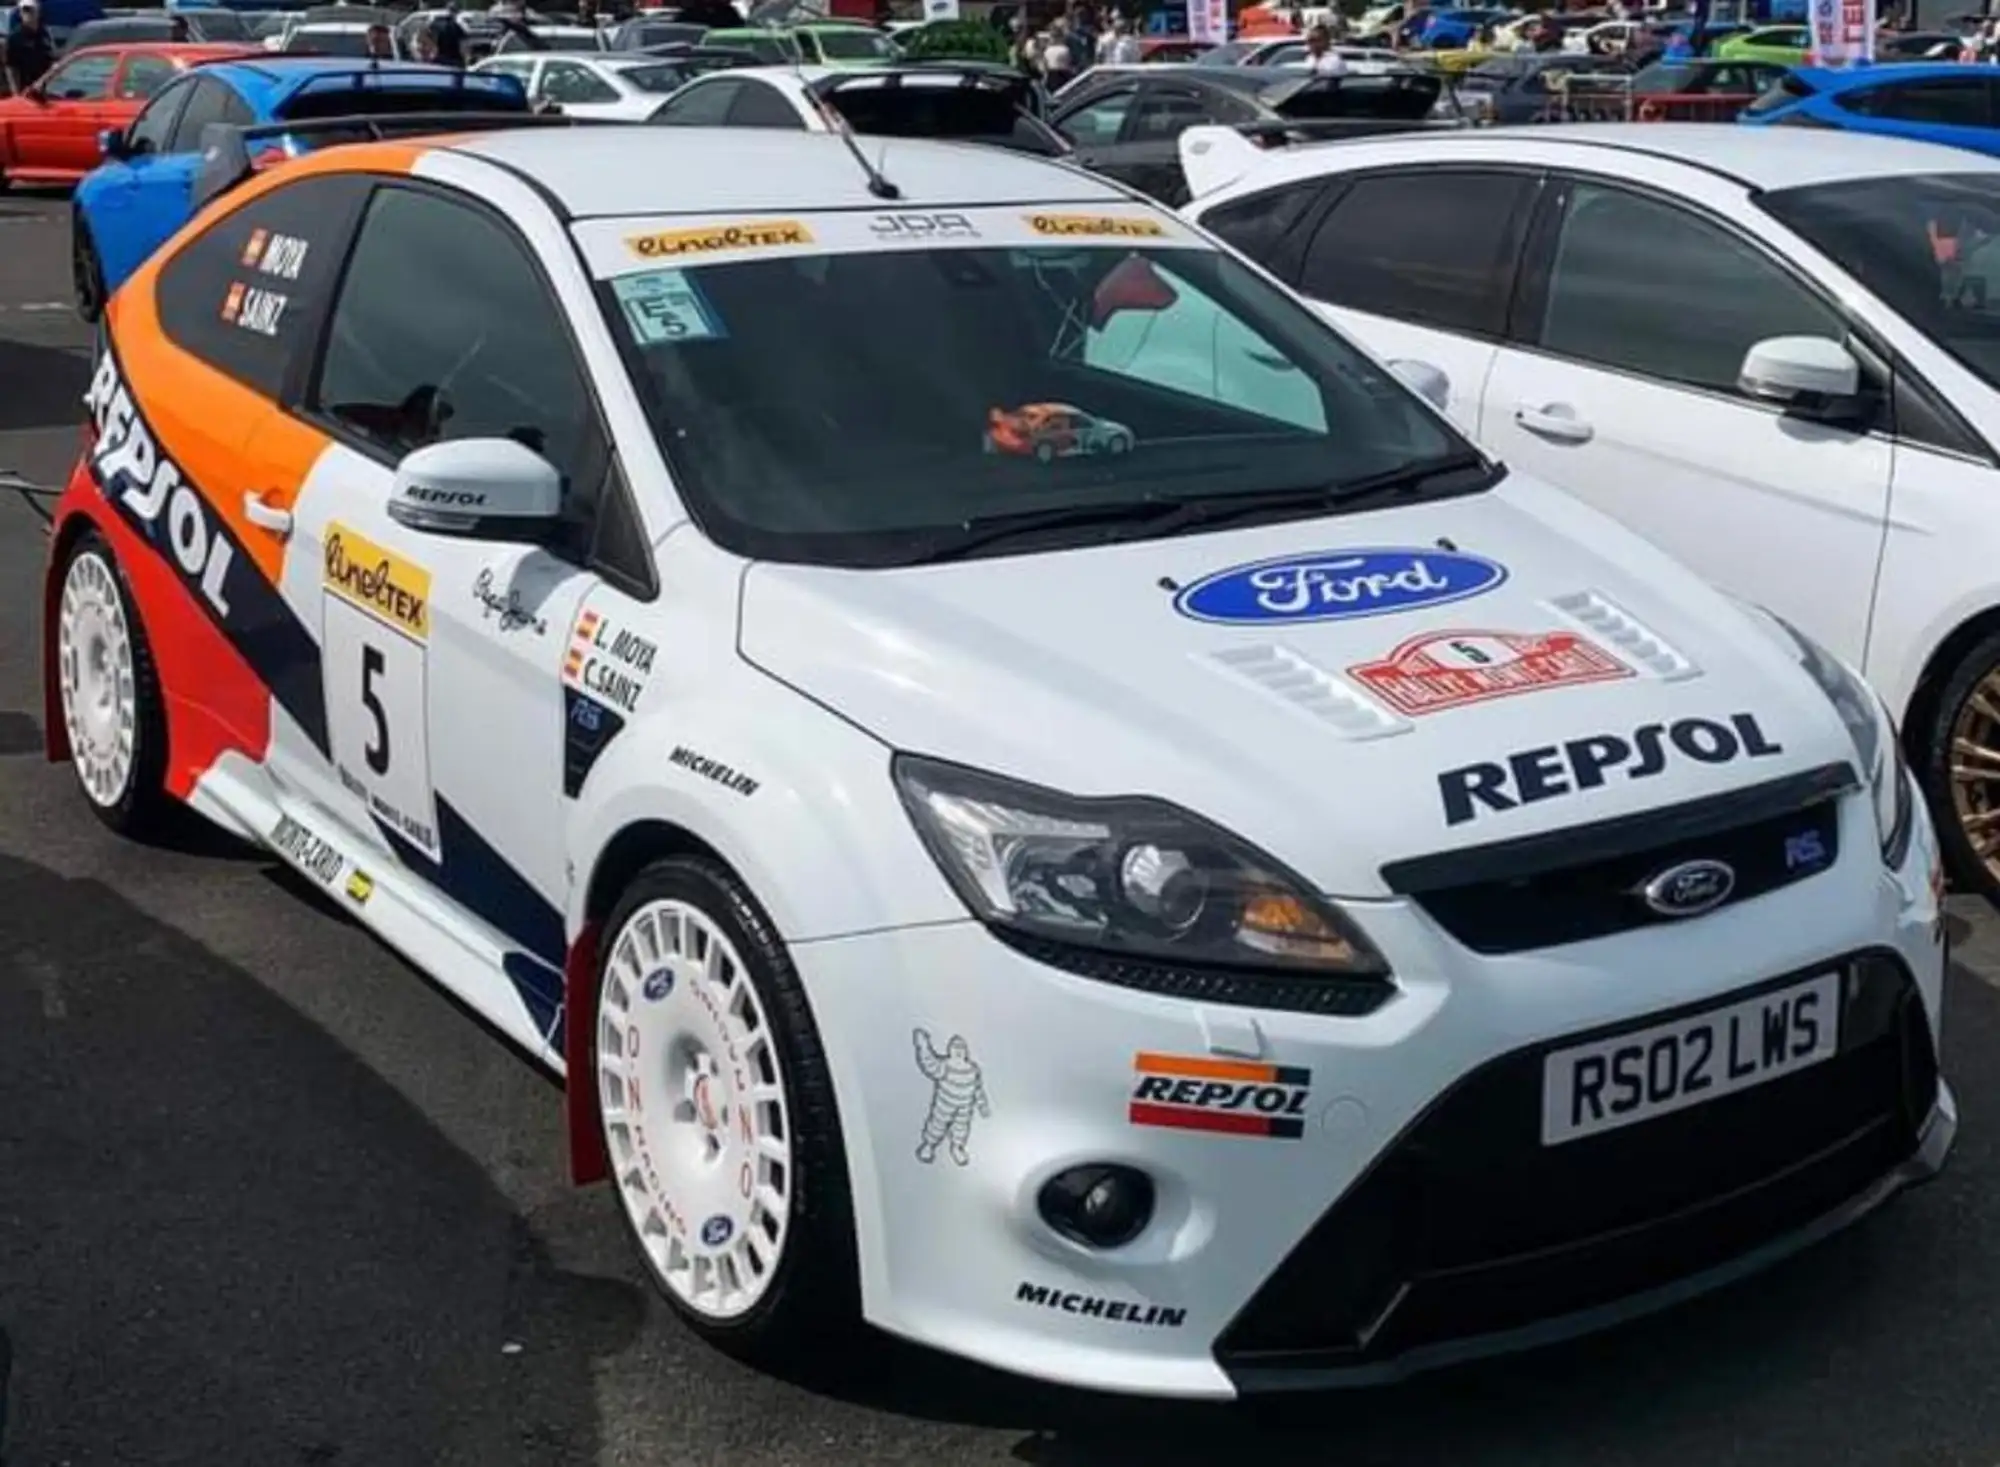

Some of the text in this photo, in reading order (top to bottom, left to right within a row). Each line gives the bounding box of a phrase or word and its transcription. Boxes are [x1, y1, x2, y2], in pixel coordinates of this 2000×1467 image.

[260, 233, 309, 279] MOYA
[238, 286, 288, 336] SAINZ
[84, 349, 233, 618] REPSOL
[405, 484, 488, 507] REPSOL
[1250, 557, 1448, 613] Ford
[609, 627, 659, 676] MOYA
[1450, 640, 1491, 664] 5
[362, 645, 391, 777] 5
[669, 744, 761, 798] MICHELIN
[1437, 713, 1783, 827] REPSOL
[1571, 990, 1820, 1127] RS02 LWS
[1131, 1075, 1311, 1115] REPSOL
[1016, 1281, 1187, 1327] MICHELIN
